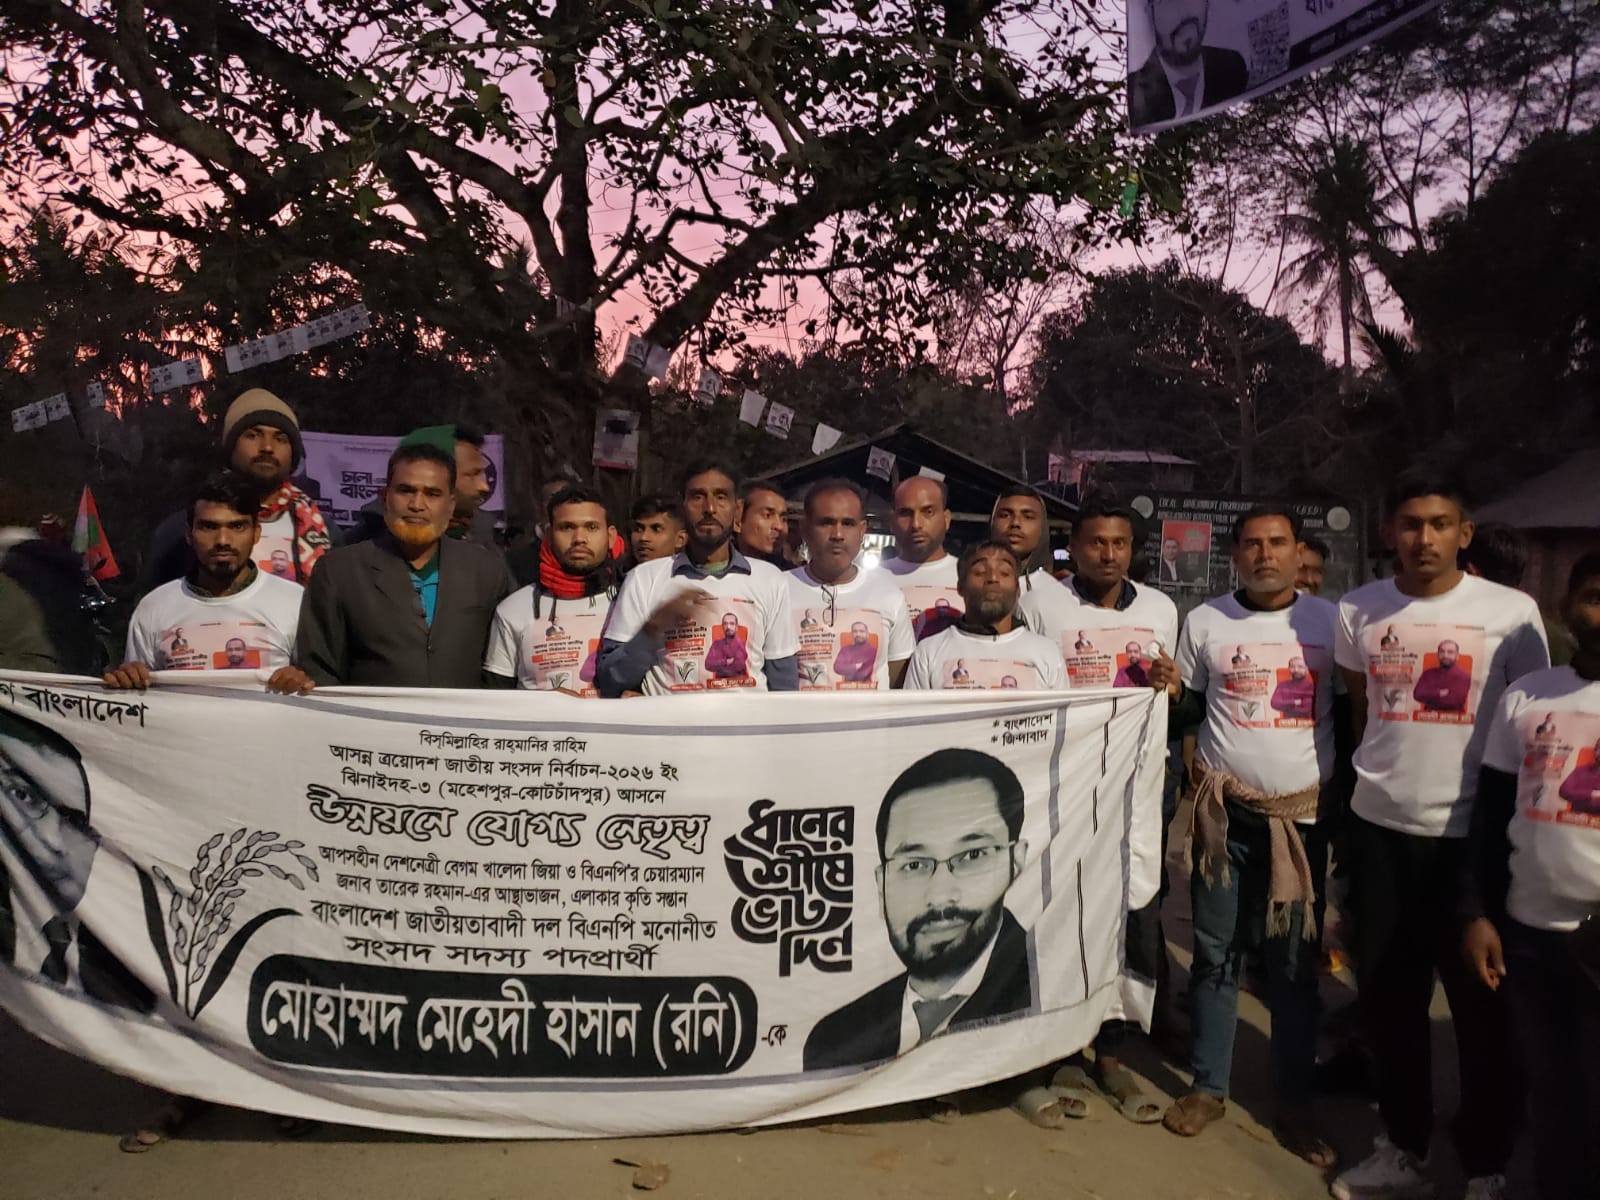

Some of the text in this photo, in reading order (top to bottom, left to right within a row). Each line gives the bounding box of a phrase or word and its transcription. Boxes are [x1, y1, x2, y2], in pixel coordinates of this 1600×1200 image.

[22, 686, 149, 728] বাংলাদেশ
[1003, 713, 1053, 730] বাংলাদেশ
[328, 744, 374, 767] আসন্ন
[379, 751, 440, 771] ত্রয়োদশ
[444, 754, 495, 774] জাতীয়
[499, 761, 544, 777] সংসদ
[660, 761, 679, 781] ইং
[553, 737, 587, 753] রাহিম
[341, 766, 431, 794] ঝিনাইদহ-৩
[617, 788, 666, 804] আসনে
[306, 783, 711, 859] উন্নয়নে যোগ্য নেতৃত্ব
[740, 798, 854, 854] ধানের
[318, 845, 379, 870] আপসহীন
[383, 852, 441, 875] দেশনেত্রী
[444, 860, 479, 878] বেগম
[483, 863, 528, 881] খালেদা
[531, 858, 560, 881] জিয়া
[565, 863, 576, 879] ও
[643, 865, 706, 884] চেয়ারম্যান
[724, 834, 853, 904] শীষে
[336, 873, 371, 895] জনাব
[376, 878, 419, 898] তারেক
[424, 882, 491, 902] রহমান-এর
[570, 889, 620, 907] এলাকার
[624, 886, 652, 913] কৃতি
[656, 890, 689, 908] সন্তান
[310, 900, 718, 942] বাংলাদেশ জাতীয়তাবাদী দল বিএনপি মনোনীত
[730, 890, 853, 943] ভোট
[344, 936, 660, 971] সংসদ সদস্য পদপ্রার্থী
[779, 919, 853, 977] দিন
[260, 979, 407, 1051] মোহাম্মদ
[415, 977, 536, 1057] মেহেদী
[544, 998, 643, 1058] হাসান
[651, 981, 742, 1070] (রনি)
